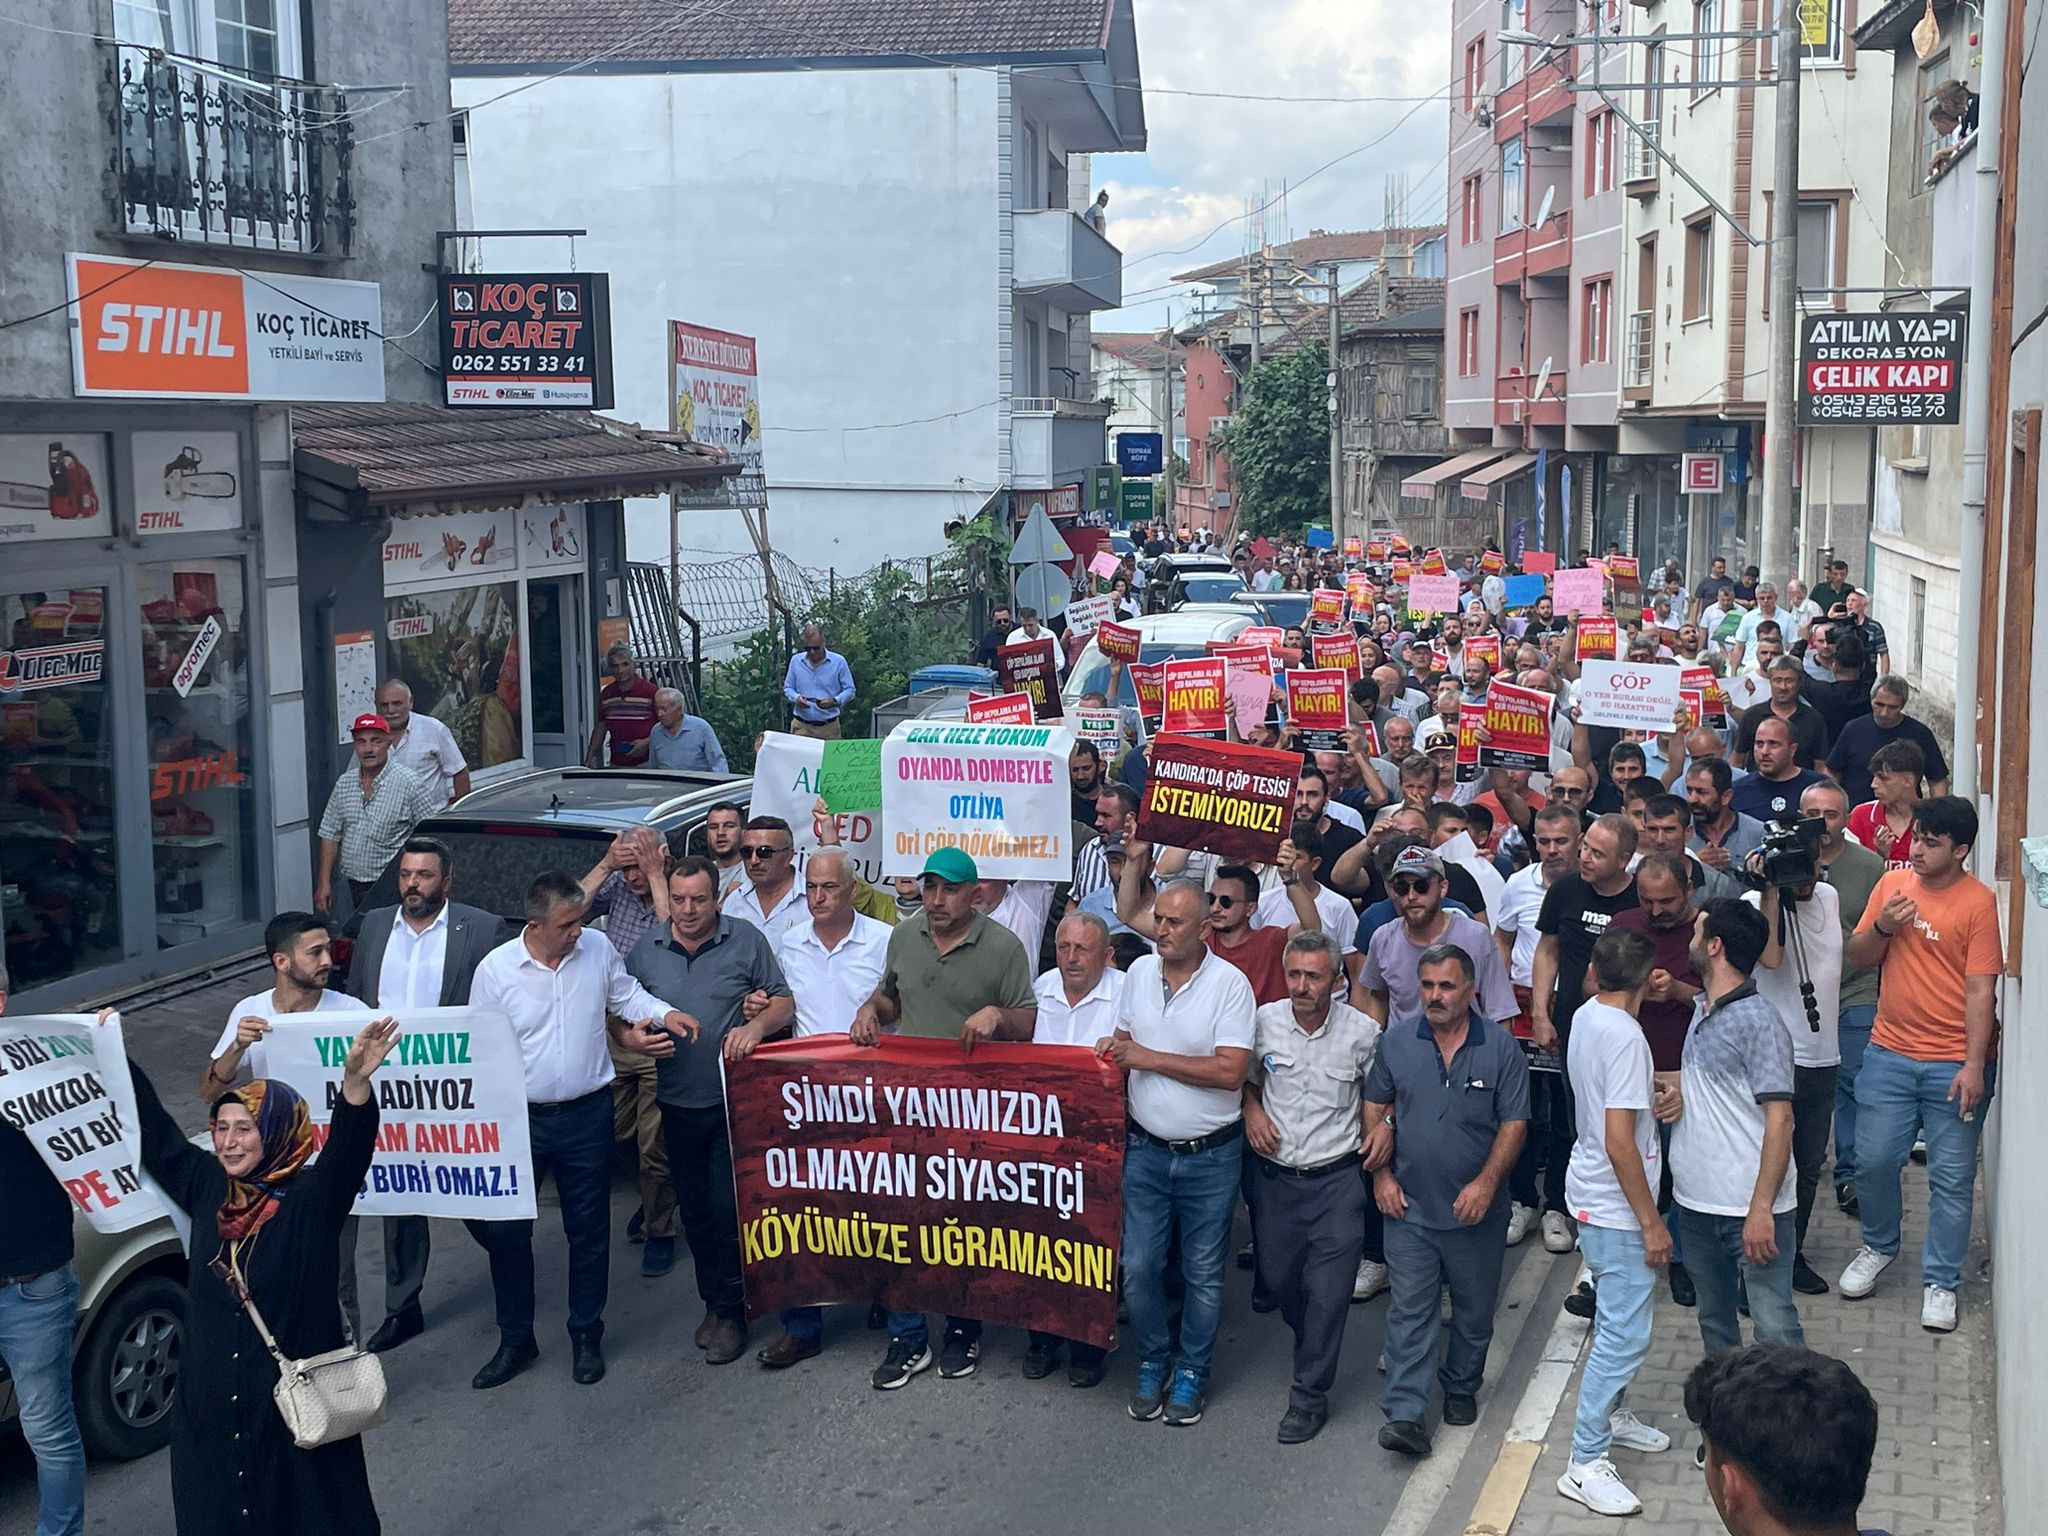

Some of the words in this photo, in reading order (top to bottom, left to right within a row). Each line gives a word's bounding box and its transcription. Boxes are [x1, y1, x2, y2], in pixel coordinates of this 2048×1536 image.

[480, 283, 549, 320] KOÇ
[98, 302, 235, 358] STIHL
[256, 313, 294, 341] KOÇ
[300, 311, 370, 340] TİCARET
[1809, 320, 1891, 343] ATILIM
[1898, 319, 1956, 342] YAPI
[269, 345, 303, 359] YETKİLİ
[305, 347, 323, 360] BAYİ
[335, 348, 363, 363] SERVİS
[452, 355, 495, 371] 0262
[500, 356, 531, 371] 551
[537, 356, 559, 371] 33
[564, 356, 585, 372] 41
[1817, 346, 1946, 359] DEKORASYON
[1888, 365, 1948, 387] KAPI
[452, 389, 490, 399] STIHL
[693, 378, 712, 407] KOÇ
[714, 376, 747, 409] TİCARET
[1822, 394, 1865, 405] 0543
[1869, 394, 1896, 405] 216
[1900, 394, 1922, 405] 47
[1925, 394, 1945, 405] 73
[1821, 406, 1862, 418] 0542
[1865, 406, 1898, 418] 564
[1901, 406, 1922, 418] 92
[1925, 406, 1945, 418] 70
[139, 511, 184, 529] STIHL
[384, 542, 423, 562] STIHL
[393, 618, 428, 638] STIHL
[176, 622, 215, 688] agromec
[1318, 653, 1357, 668] HAYIR!
[1140, 685, 1163, 700] HAY
[1610, 672, 1651, 691] ÇÖP
[1169, 688, 1219, 711] HAYIR!
[1294, 694, 1341, 712] HAYIR!
[942, 728, 986, 746] HELE
[987, 728, 1051, 747] KOKUM
[1487, 710, 1545, 736] HAYIR!
[151, 752, 245, 800] STIHL
[898, 757, 964, 782] OYANDA
[967, 758, 1053, 785] DOMBEYLE
[1155, 759, 1223, 787] KANDIRA'DA
[1225, 770, 1250, 792] ÇÖP
[1253, 775, 1291, 799] TESİSİ
[949, 791, 1004, 821] OTLİYA
[1150, 780, 1283, 834] İSTEMİYORUZ!
[960, 827, 1059, 859] DÖKÜLMEZ.!
[2, 1034, 50, 1071] SİZİ
[397, 1032, 472, 1066] YAVIZ
[3, 1072, 107, 1130] ŞIMIZDA
[781, 1076, 877, 1129] ŞİMDİ
[883, 1085, 1064, 1138] YANIMIZDA
[47, 1127, 95, 1162] SİZ
[415, 1122, 500, 1155] ANLAN
[371, 1160, 432, 1194] BURİ
[435, 1164, 518, 1197] OMAZ.!
[765, 1147, 916, 1198] OLMAYAN
[925, 1148, 1084, 1221] SİYASETÇİ
[743, 1206, 912, 1265] KÖYÜMÜZE
[919, 1217, 1113, 1293] UĞRAMASIN!
